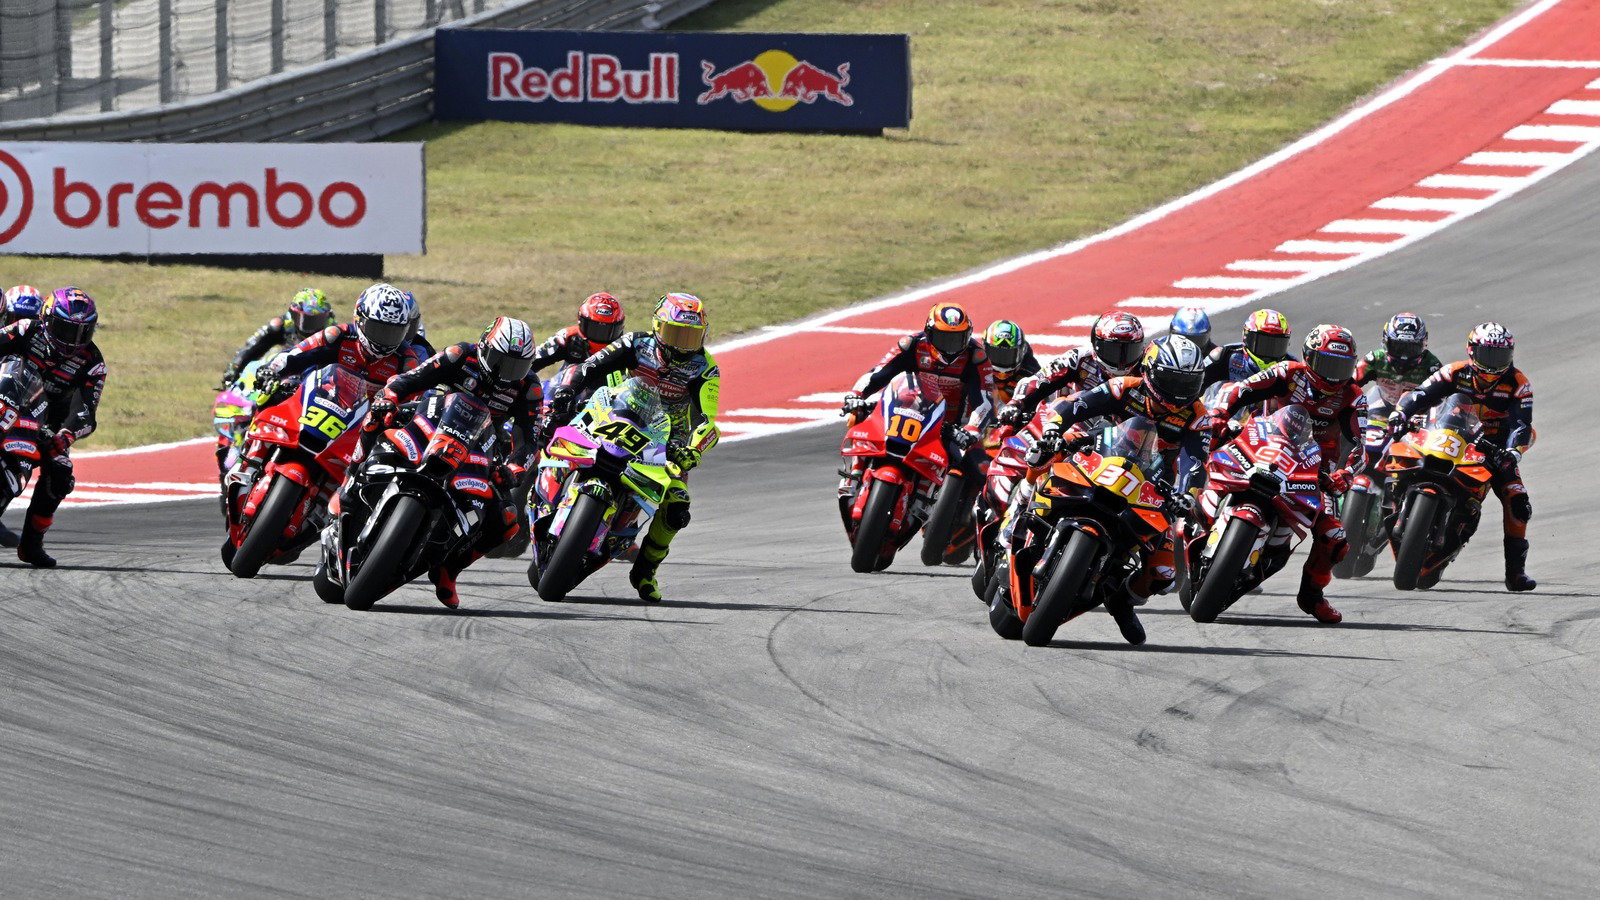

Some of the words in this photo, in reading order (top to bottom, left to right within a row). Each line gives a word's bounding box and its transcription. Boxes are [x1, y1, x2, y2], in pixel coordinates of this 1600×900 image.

[53, 167, 367, 228] brembo
[1331, 343, 1347, 351] SHOEI
[322, 400, 347, 417] Castrol
[901, 409, 924, 421] Castrol
[269, 414, 288, 427] IBM
[298, 405, 348, 439] 36
[1165, 416, 1186, 427] KTM
[442, 425, 471, 444] TARGA
[852, 431, 869, 439] IBM
[886, 414, 922, 443] 10
[592, 420, 652, 456] 49
[396, 431, 418, 460] sterilgarda
[1429, 432, 1462, 458] 23
[930, 452, 945, 464] IBM
[1221, 458, 1234, 466] TIM
[1228, 444, 1252, 469] Lenovo
[1255, 446, 1299, 475] 93
[1305, 454, 1322, 468] riello
[20, 460, 32, 470] sky
[455, 478, 487, 491] sterilgarda
[1094, 464, 1141, 497] 37
[1286, 482, 1316, 490] Lenovo
[472, 499, 485, 509] sky
[1306, 499, 1318, 509] TIM
